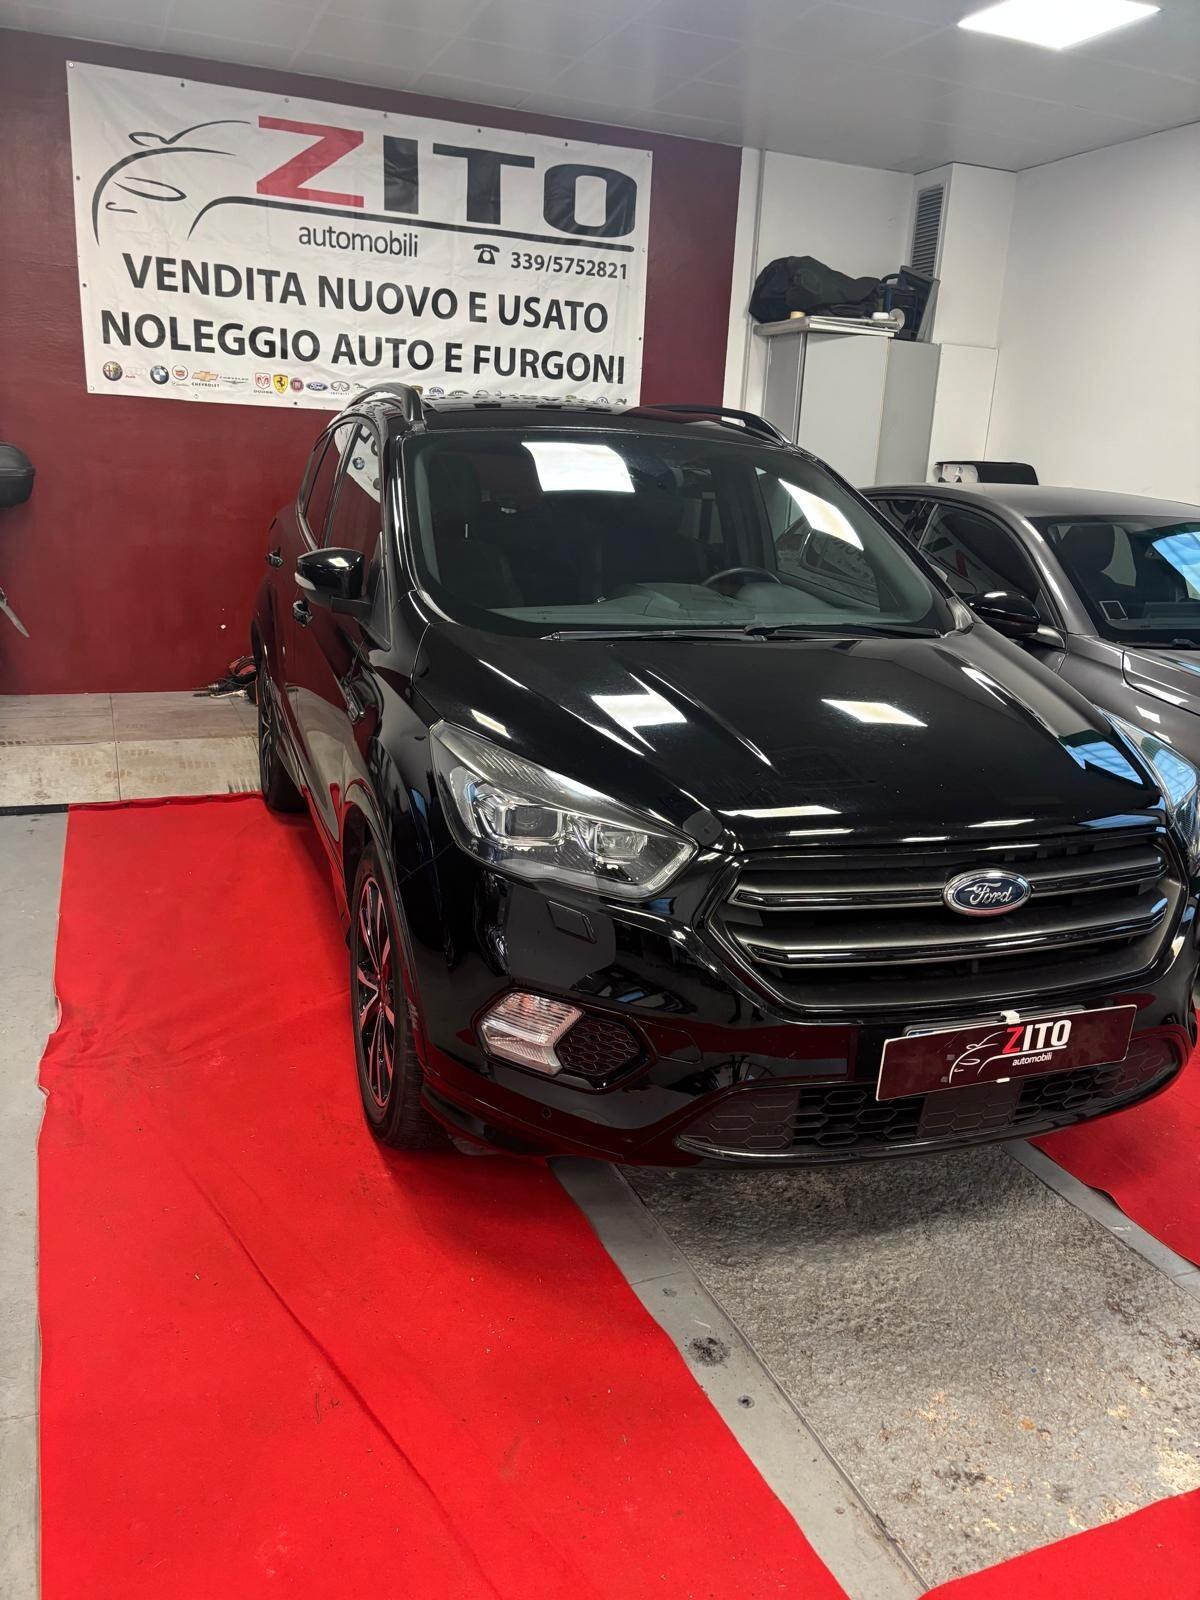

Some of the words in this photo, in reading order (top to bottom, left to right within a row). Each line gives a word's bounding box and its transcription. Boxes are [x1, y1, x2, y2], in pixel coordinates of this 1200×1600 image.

[257, 116, 637, 237] ZITO
[299, 226, 418, 257] automobili
[511, 251, 628, 280] 339/5752821
[123, 253, 306, 305] VENDITA
[319, 276, 457, 319] NUOVO
[470, 292, 487, 323] E
[499, 295, 607, 333] USATO
[102, 310, 320, 361] NOLEGGIO
[332, 334, 433, 370] AUTO
[445, 343, 462, 373] E
[474, 345, 625, 384] FURGONI
[965, 882, 1012, 905] Ford
[1002, 1019, 1072, 1054] ZITO
[1012, 1052, 1053, 1066] automobili
